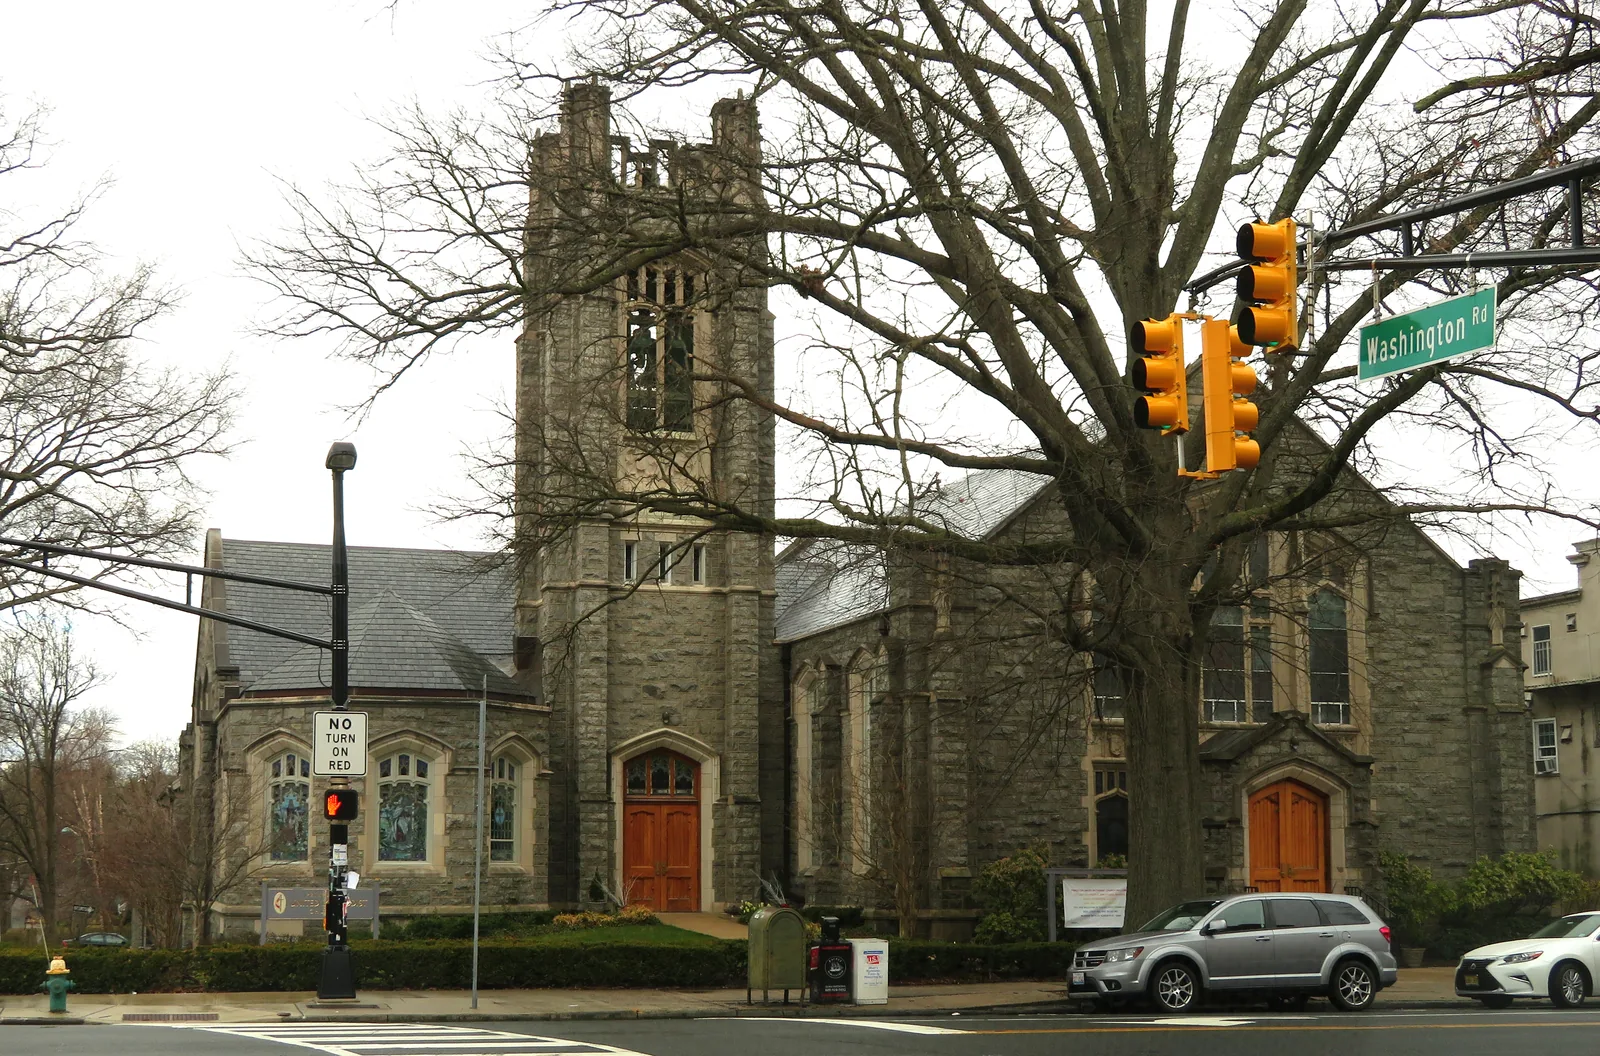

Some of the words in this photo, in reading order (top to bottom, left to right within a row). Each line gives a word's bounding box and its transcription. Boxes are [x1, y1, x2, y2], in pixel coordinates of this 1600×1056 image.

[1366, 317, 1465, 365] Washington
[1472, 304, 1487, 325] Rd
[329, 718, 352, 730] NO
[326, 733, 356, 743] TURN
[332, 747, 348, 757] ON
[329, 760, 351, 770] RED
